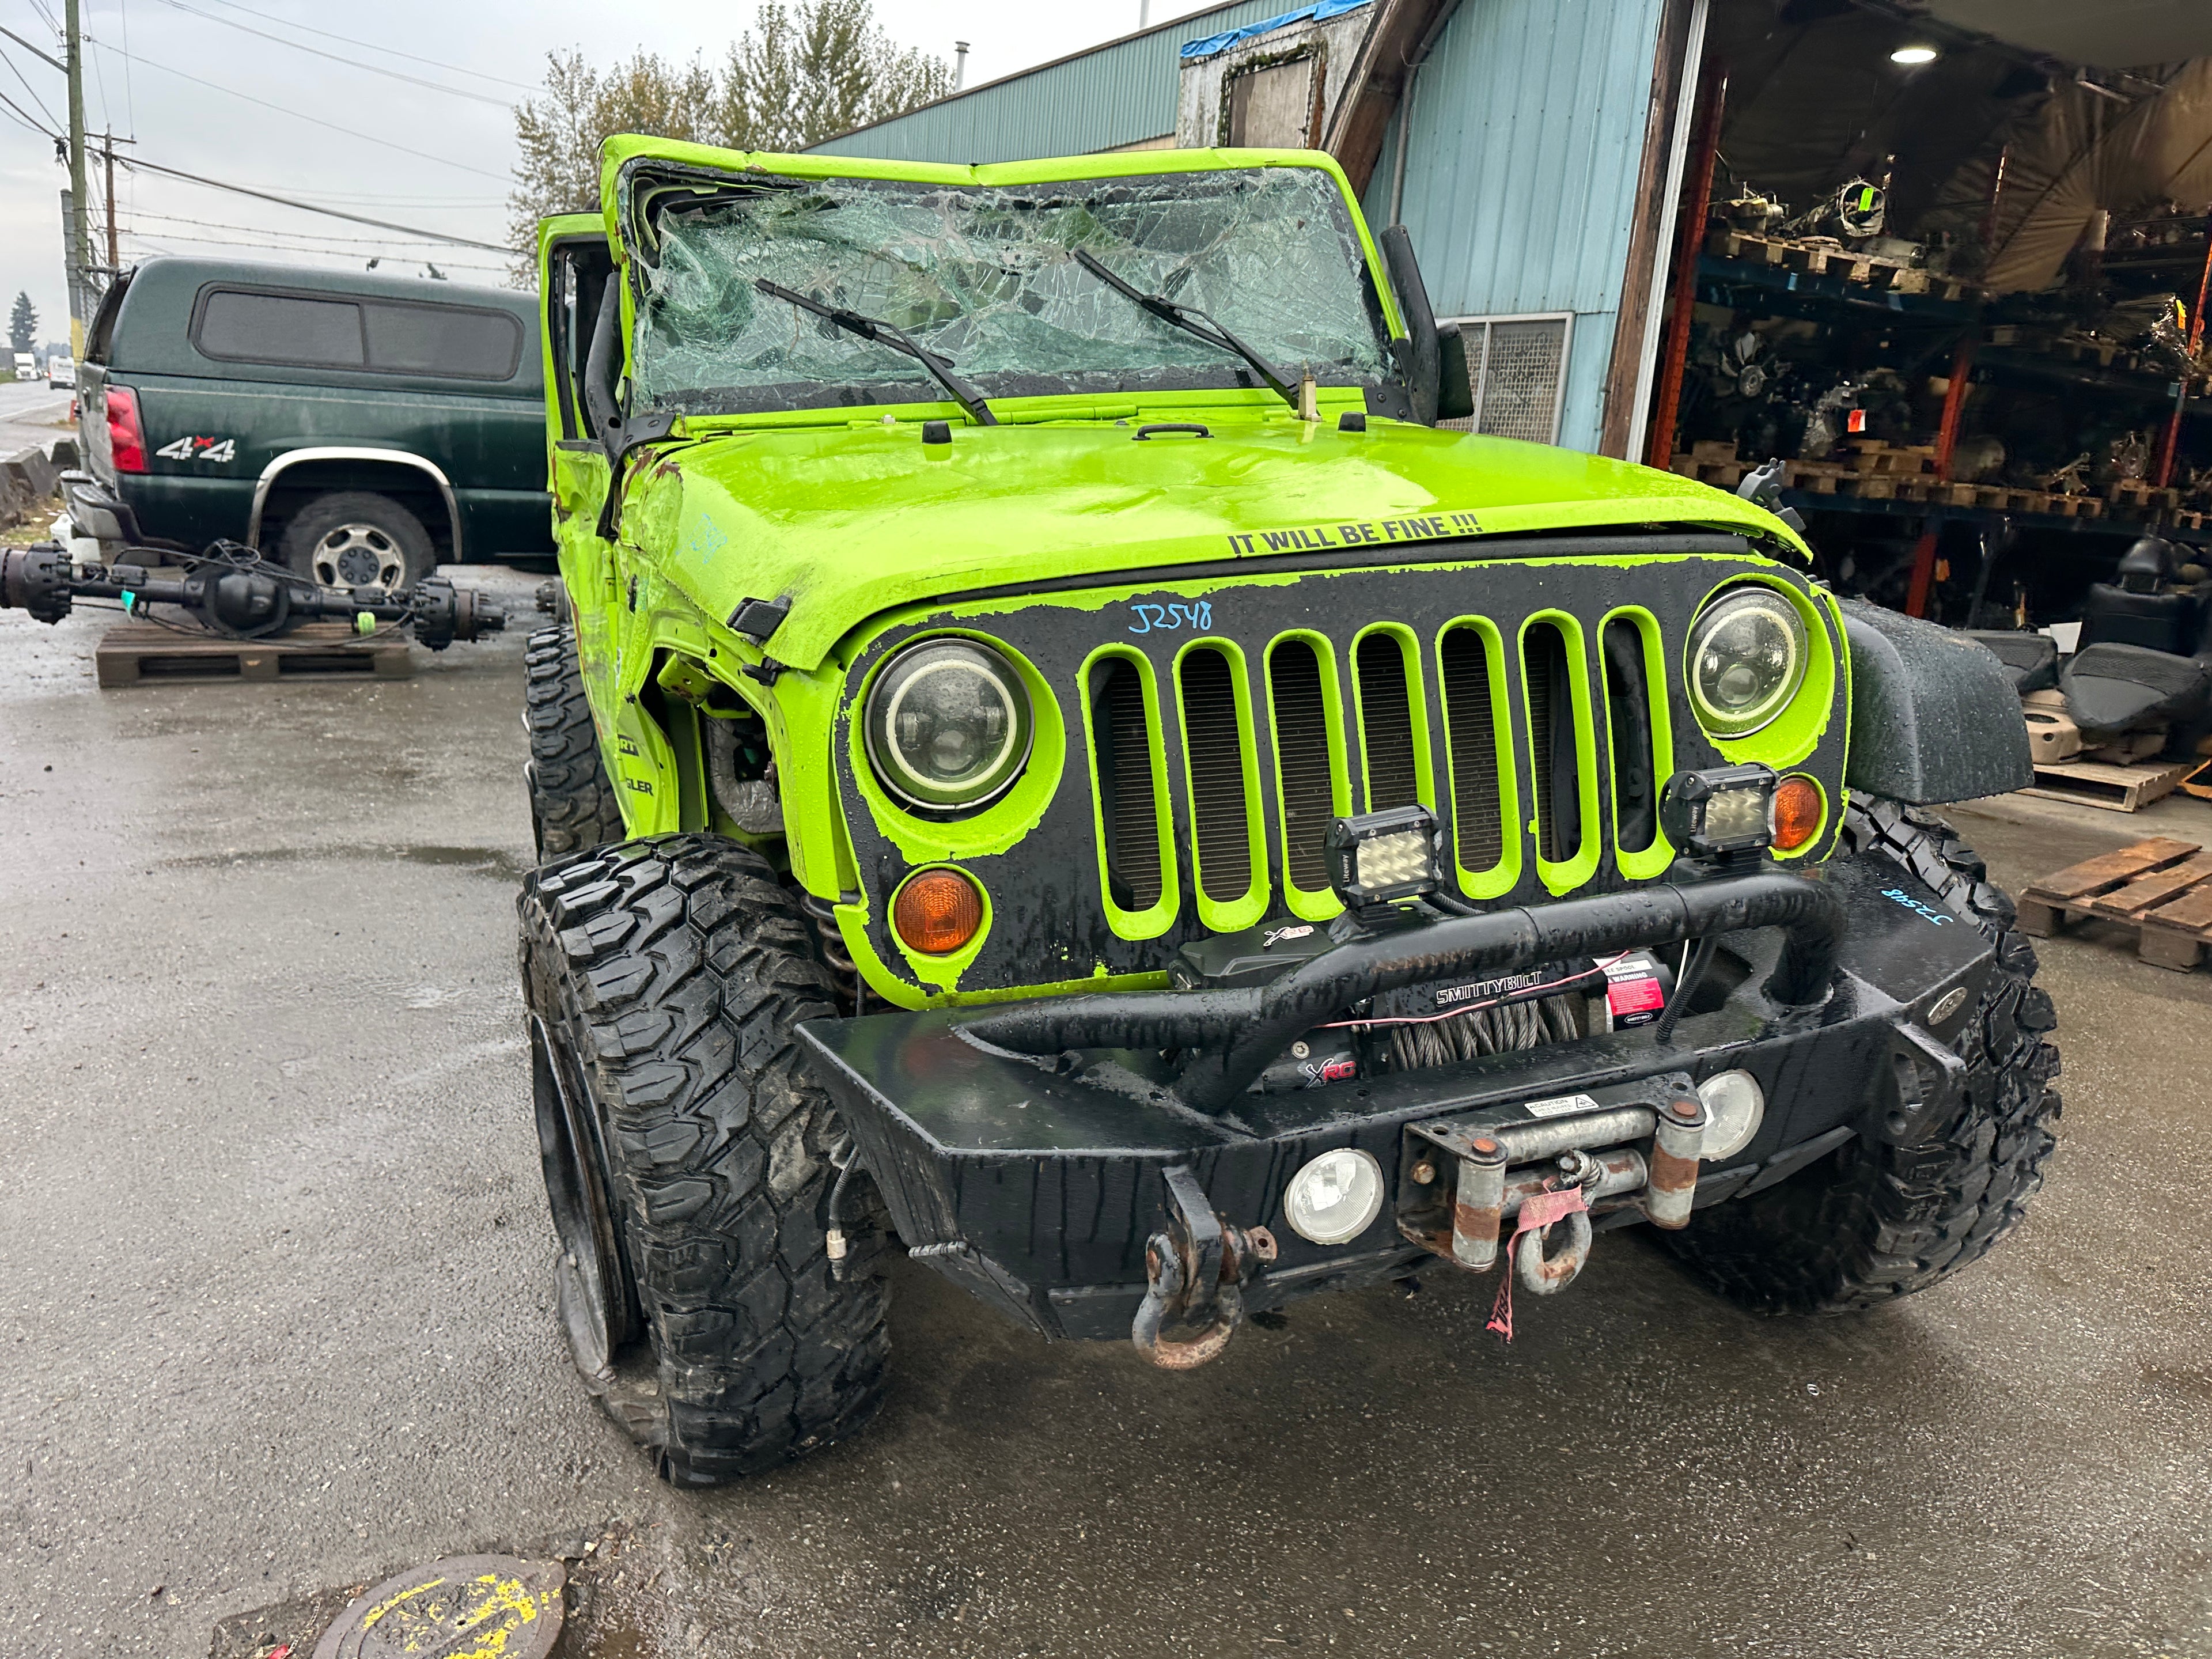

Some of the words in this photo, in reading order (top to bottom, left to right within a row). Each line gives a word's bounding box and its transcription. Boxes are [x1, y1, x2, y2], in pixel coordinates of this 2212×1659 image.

[1227, 535, 1255, 554] IT
[1260, 528, 1336, 551] WILL
[1338, 523, 1381, 544] BE
[1381, 516, 1452, 540] FINE
[1450, 514, 1483, 534] !!!
[1128, 601, 1212, 633] J2548
[1690, 806, 1699, 832] Liteway
[1342, 854, 1350, 882] Liteway
[1437, 971, 1542, 1004] SMITTYBILT
[1612, 972, 1648, 982] WARNING
[1304, 1058, 1357, 1089] XRC
